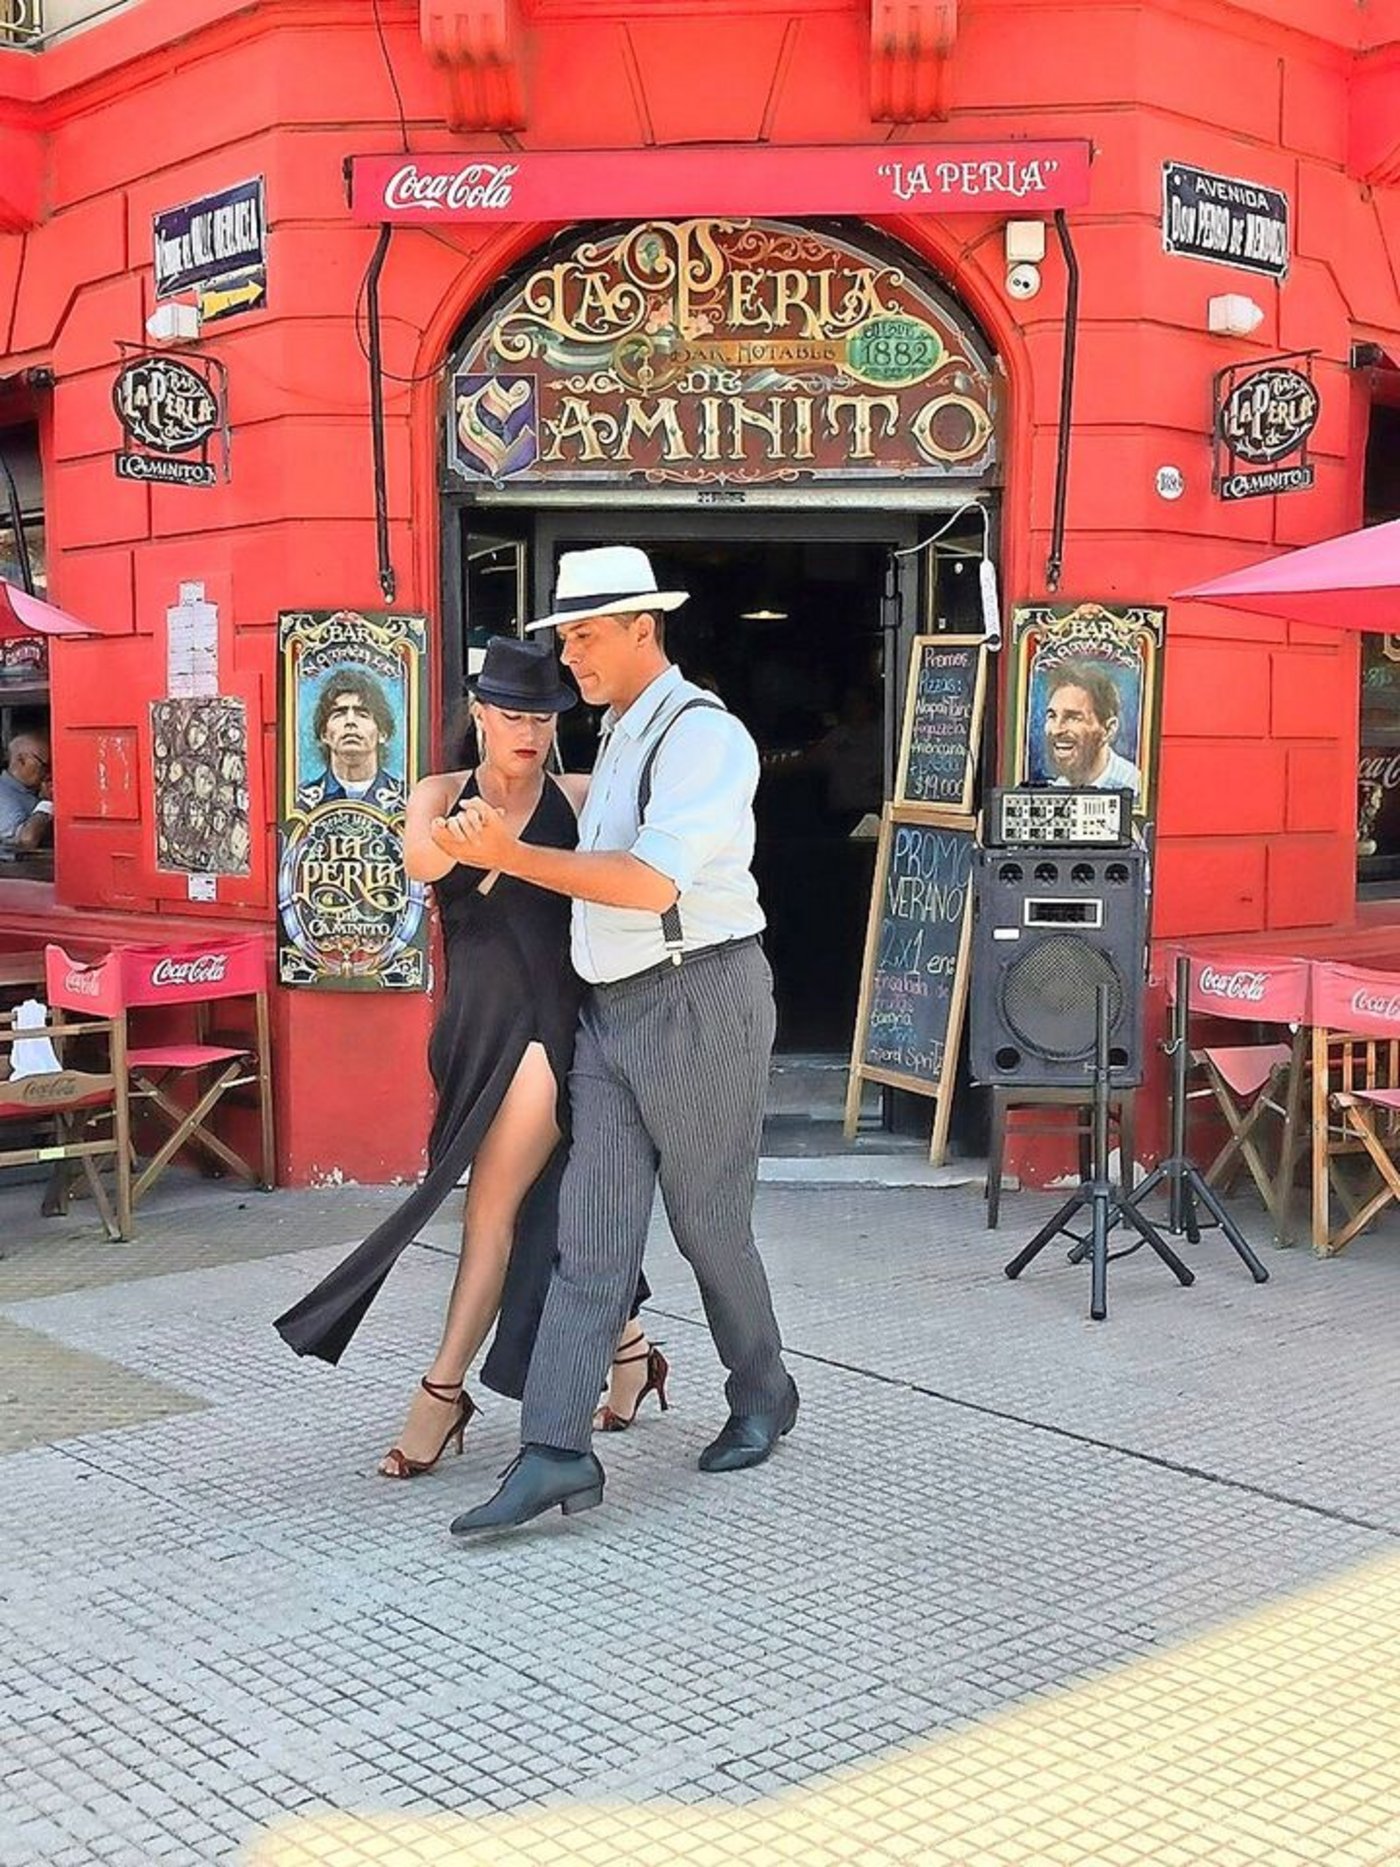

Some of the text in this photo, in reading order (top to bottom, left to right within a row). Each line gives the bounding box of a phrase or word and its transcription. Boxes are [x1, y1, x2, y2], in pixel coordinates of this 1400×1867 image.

[1195, 177, 1269, 210] AVENIDA
[1196, 200, 1230, 252] PEDRO
[505, 219, 904, 342] LA PERLA
[861, 338, 931, 366] 1882
[148, 371, 216, 430] PERLA
[1251, 382, 1316, 440] PERLA
[329, 625, 371, 643] BAR
[1071, 621, 1116, 638] BAR
[329, 835, 368, 860] LA
[301, 860, 403, 898] PERLA
[888, 876, 963, 922] VERANO
[309, 919, 391, 937] CAMINITO
